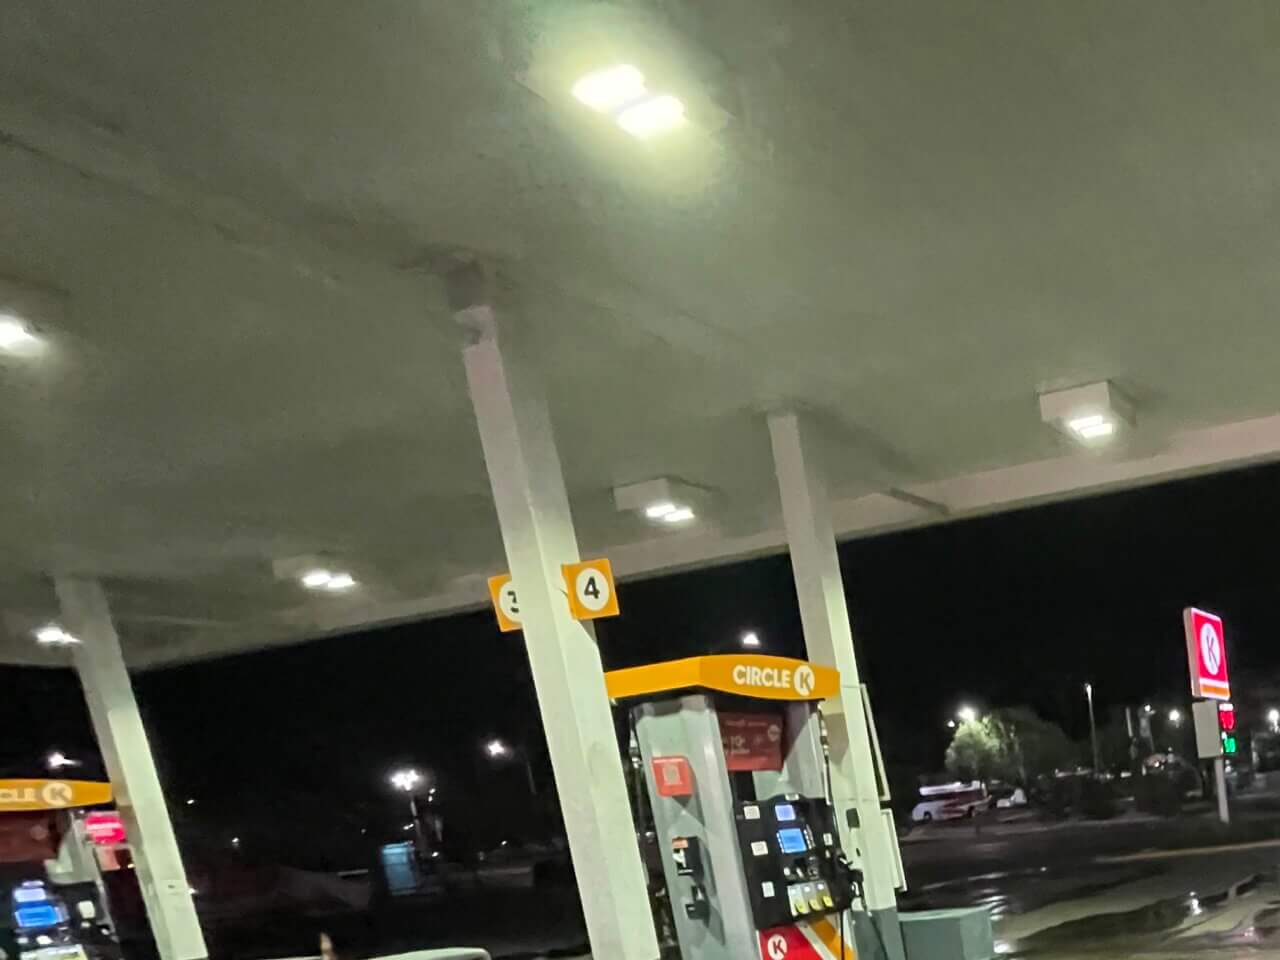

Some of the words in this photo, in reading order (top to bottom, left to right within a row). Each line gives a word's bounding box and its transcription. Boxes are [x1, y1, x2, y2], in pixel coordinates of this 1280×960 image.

[583, 576, 600, 599] 4
[1203, 629, 1220, 672] K
[733, 664, 791, 688] CIRCLE
[797, 668, 814, 694] K
[47, 785, 72, 804] K
[771, 937, 787, 958] K
